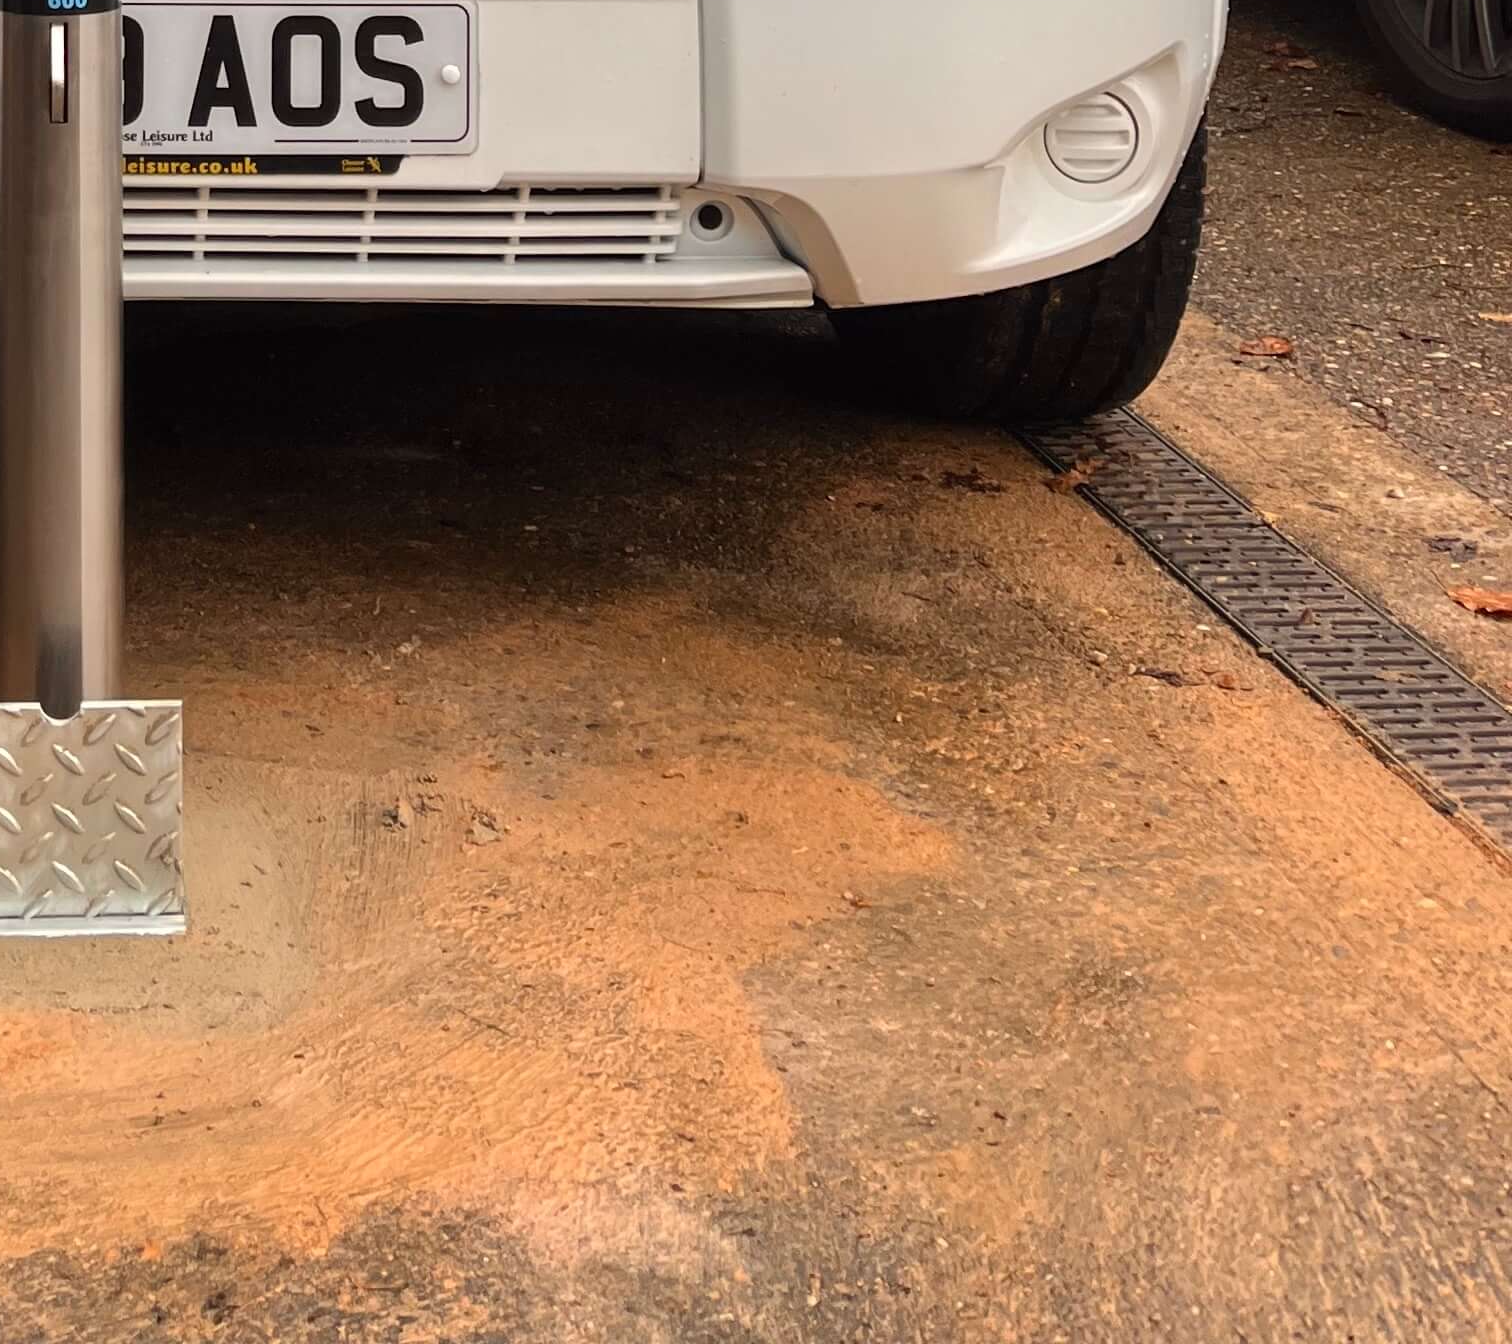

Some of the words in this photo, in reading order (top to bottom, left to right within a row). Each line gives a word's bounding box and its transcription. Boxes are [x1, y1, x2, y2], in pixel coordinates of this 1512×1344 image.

[188, 14, 425, 127] AOS
[142, 129, 189, 143] Leisure
[192, 129, 214, 143] Ltd
